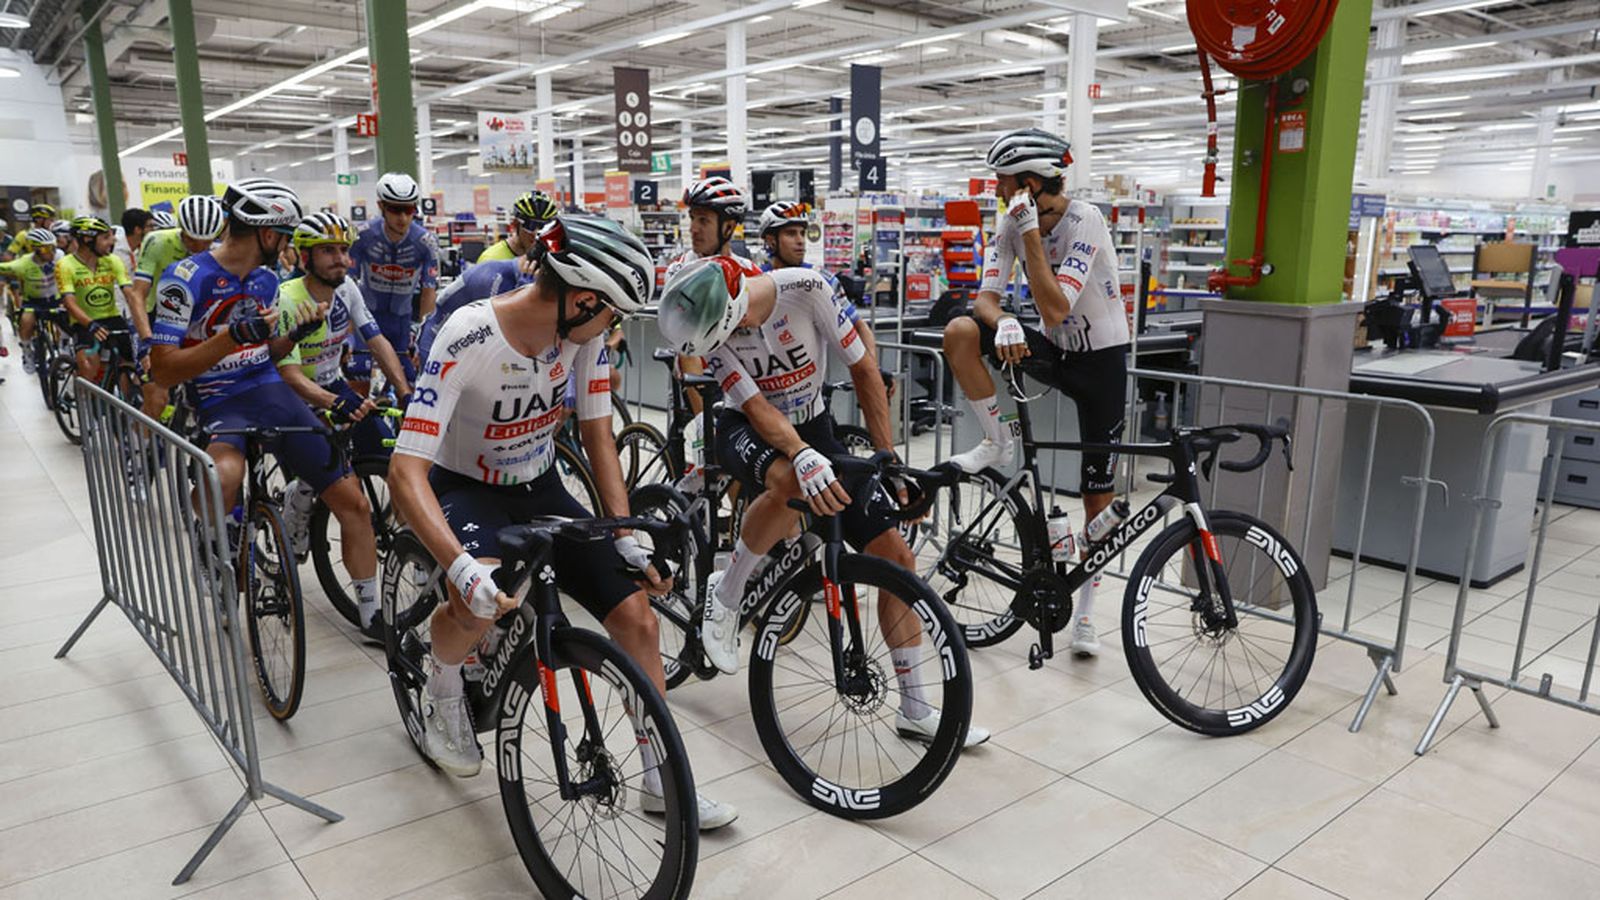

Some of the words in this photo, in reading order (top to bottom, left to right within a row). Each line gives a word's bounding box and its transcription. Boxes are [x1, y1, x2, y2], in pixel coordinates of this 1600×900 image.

[138, 167, 188, 178] Pensan
[866, 166, 880, 185] 4
[144, 184, 190, 195] Financi
[640, 185, 652, 200] 2
[780, 278, 824, 292] presight
[447, 324, 494, 359] presight
[740, 343, 812, 379] UAE
[757, 364, 816, 391] mirates
[492, 378, 569, 423] UAE
[1084, 504, 1158, 574] COLNAGO
[740, 546, 802, 616] COLNAGO
[483, 614, 525, 698] COLNAGO
